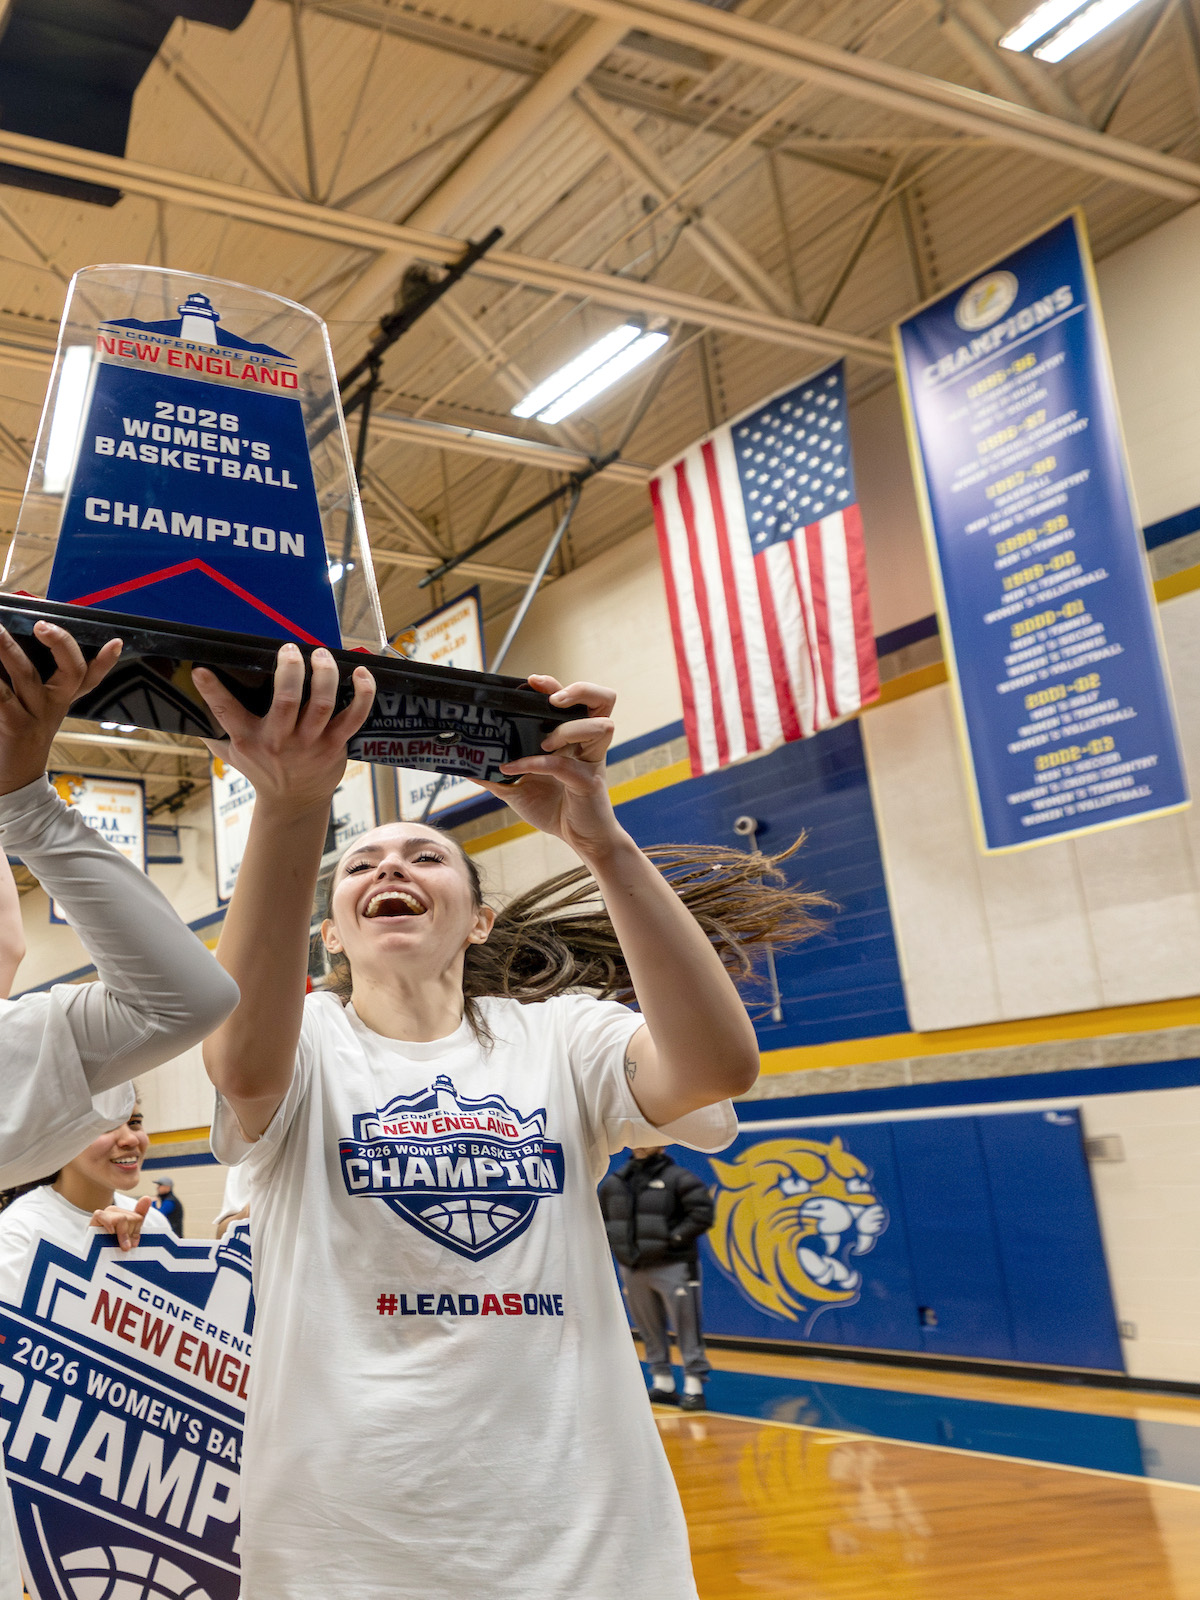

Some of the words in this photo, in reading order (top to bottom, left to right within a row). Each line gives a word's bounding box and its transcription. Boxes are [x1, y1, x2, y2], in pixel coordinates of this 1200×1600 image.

[126, 332, 244, 360] CONFERENCE
[249, 355, 272, 365] OF
[922, 283, 1072, 387] CHAMPIONS
[97, 336, 160, 363] NEW
[168, 350, 298, 390] ENGLAND
[155, 401, 239, 432] 2026
[122, 417, 271, 461] WOMEN'S
[95, 436, 298, 490] BASKETBALL
[85, 497, 305, 558] CHAMPION
[383, 1121, 428, 1135] NEW
[432, 1117, 520, 1138] ENGLAND
[345, 1156, 558, 1190] CHAMPION
[358, 1145, 391, 1158] 2026
[395, 1144, 466, 1156] WOMEN'S
[473, 1143, 543, 1160] BASKETBA
[90, 1288, 175, 1358] NEW
[376, 1293, 564, 1316] #LEADASONE
[12, 1337, 80, 1386] 2026
[86, 1369, 203, 1445] WOMEN'S
[206, 1428, 243, 1464] BA
